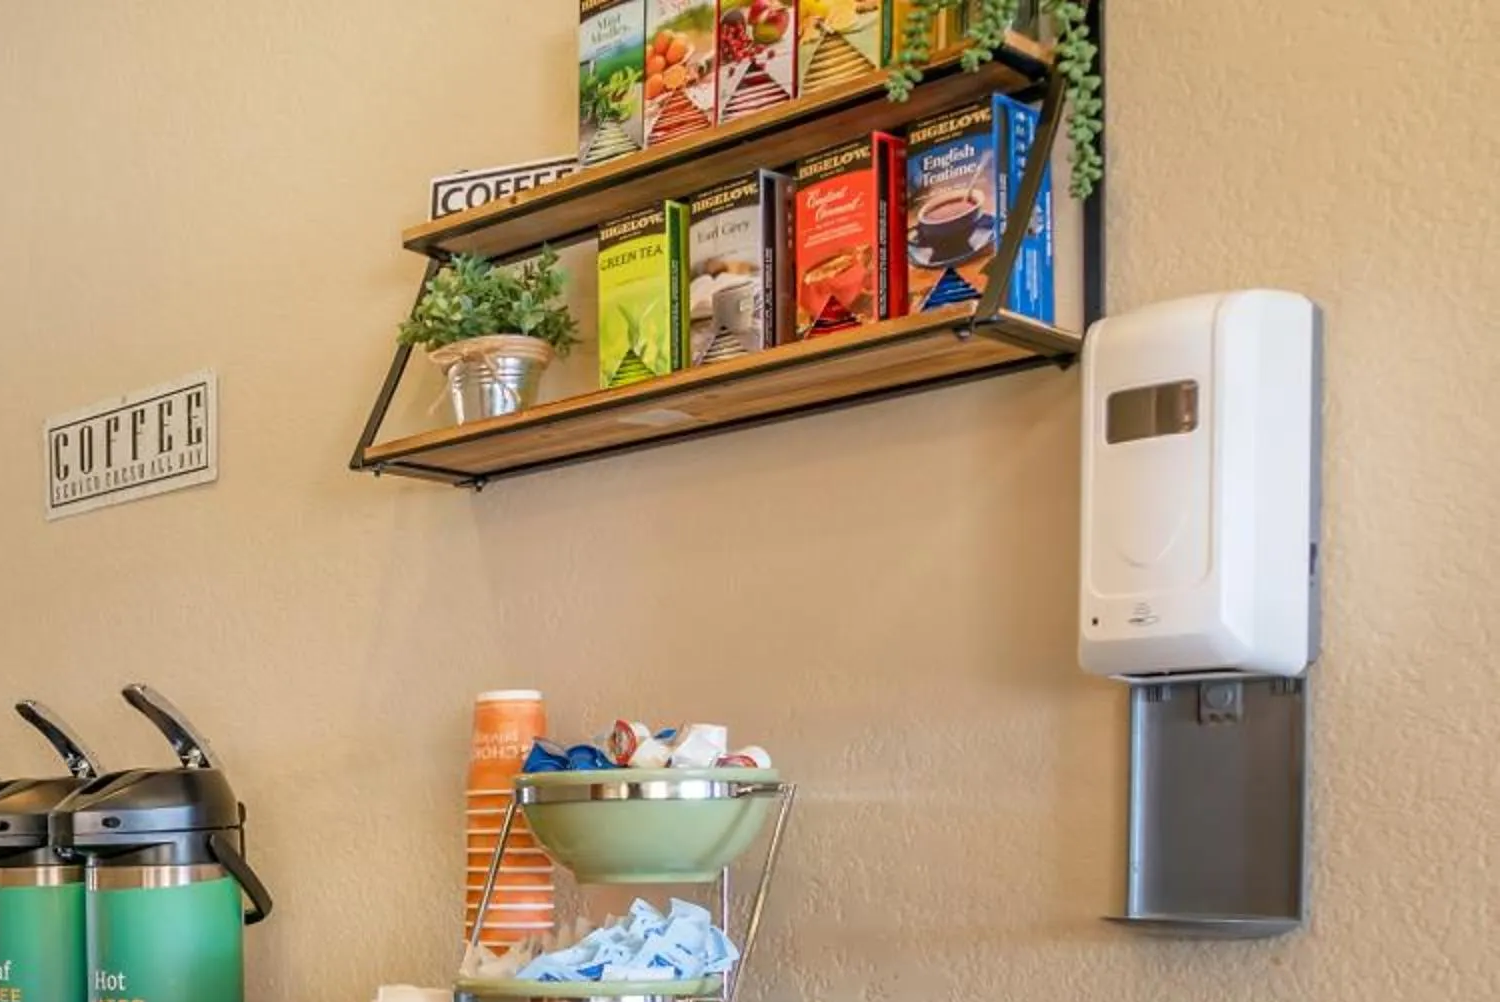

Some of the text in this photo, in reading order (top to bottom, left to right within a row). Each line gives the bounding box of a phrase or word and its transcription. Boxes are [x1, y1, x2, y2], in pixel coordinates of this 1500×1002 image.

[909, 107, 992, 145] BIGELOW
[798, 145, 871, 179] BIGELOW
[922, 143, 975, 171] English
[921, 162, 977, 188] Teatime
[692, 182, 759, 213] BIGELOW
[600, 211, 664, 241] BIGELOW
[600, 243, 664, 271] GREEN TEA
[54, 391, 202, 482] COFFEE
[94, 970, 127, 991] Hot
